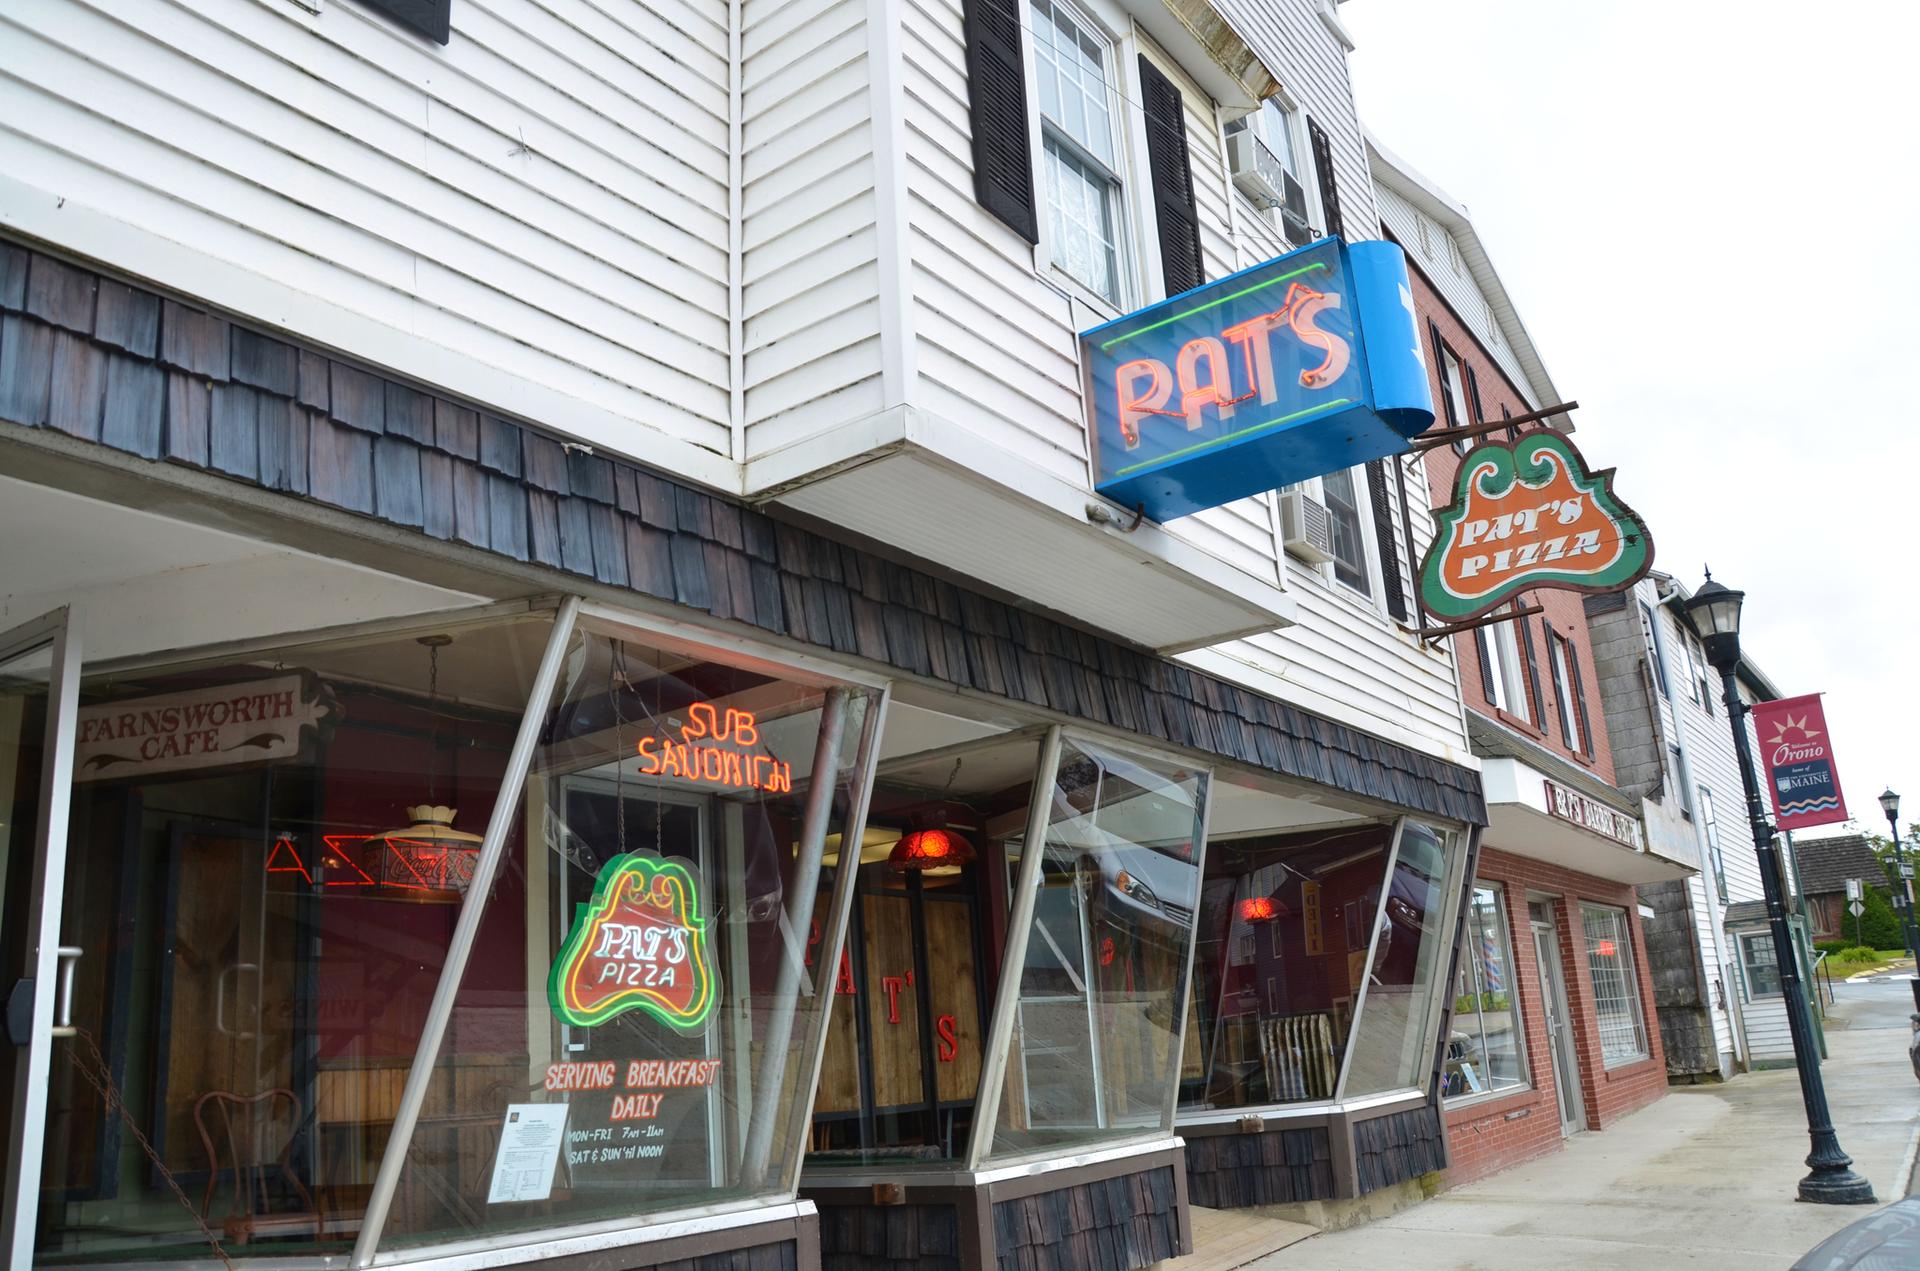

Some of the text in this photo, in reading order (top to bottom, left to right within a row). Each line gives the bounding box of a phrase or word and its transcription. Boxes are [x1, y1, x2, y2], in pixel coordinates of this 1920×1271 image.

[1115, 283, 1350, 451] PAT'S
[1458, 496, 1583, 548] PAT'S
[1458, 529, 1601, 580] PIZZA
[79, 690, 295, 744] FARNSWORTH
[681, 702, 758, 746] SUB
[139, 728, 219, 761] CAFE
[1772, 743, 1824, 767] Orono
[1791, 774, 1830, 788] MAINE
[593, 922, 689, 964] PAT'S
[597, 961, 675, 987] PIZZA
[544, 1060, 721, 1091] SERVING BREAKFAST
[609, 1093, 664, 1121] DAILY
[566, 1127, 613, 1143] MON-FRI
[569, 1149, 591, 1165] SAT
[600, 1147, 622, 1162] SUN
[637, 1145, 664, 1159] NOON
